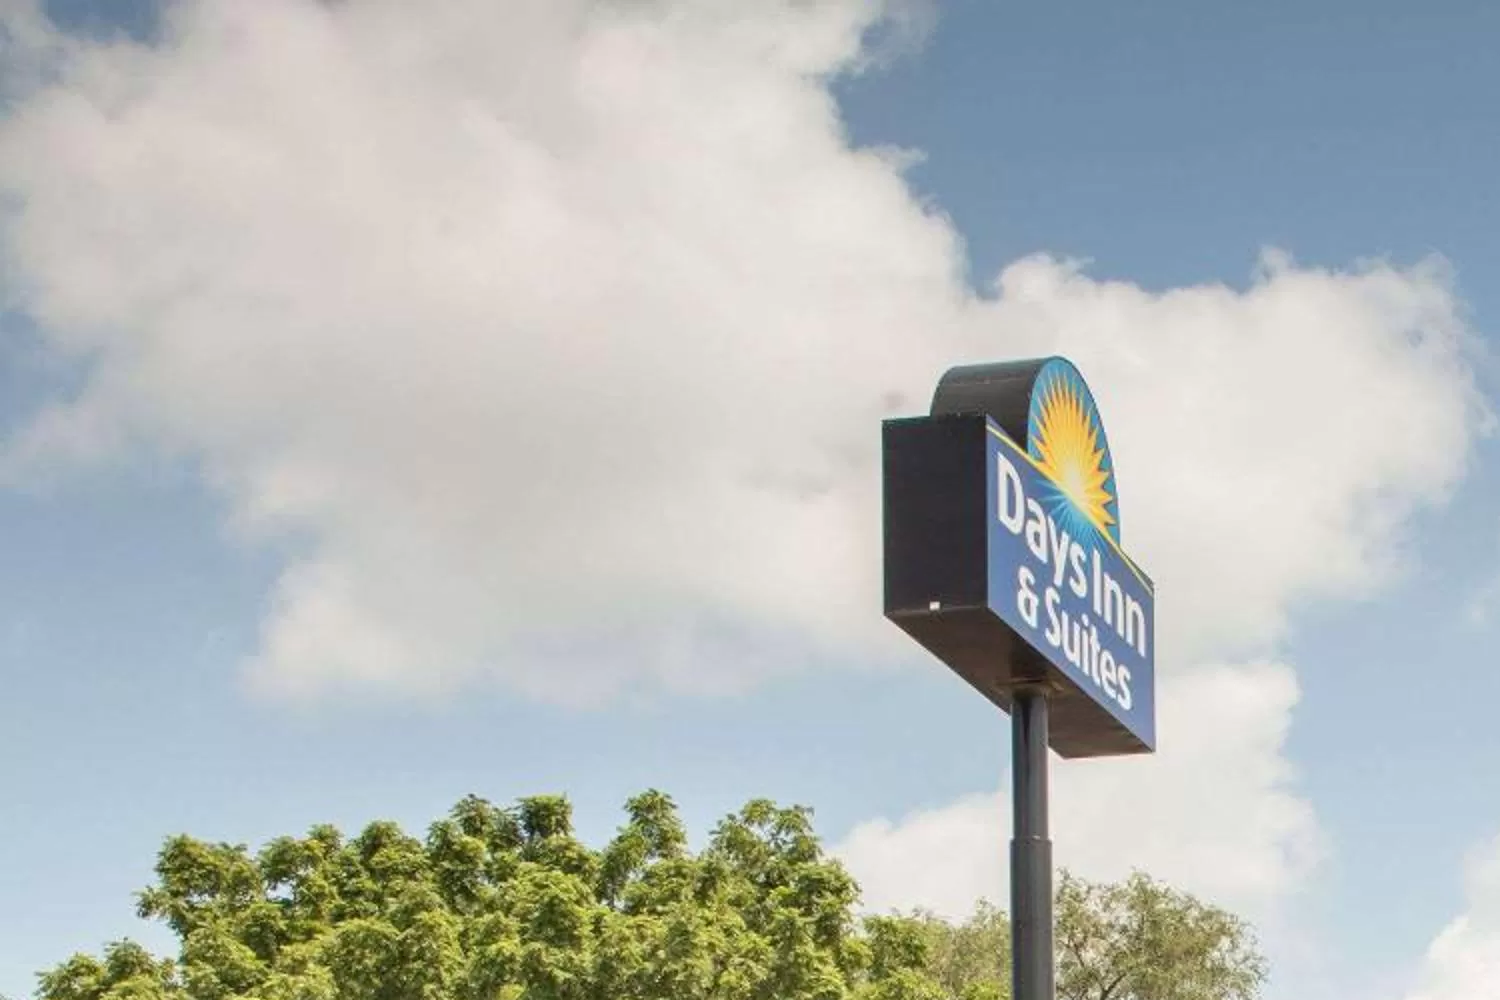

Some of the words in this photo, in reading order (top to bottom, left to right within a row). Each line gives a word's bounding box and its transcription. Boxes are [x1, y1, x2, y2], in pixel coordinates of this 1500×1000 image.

[997, 451, 1087, 598] Days
[1092, 548, 1147, 658] Inn
[1017, 566, 1039, 630] &
[1044, 586, 1133, 711] Suites
